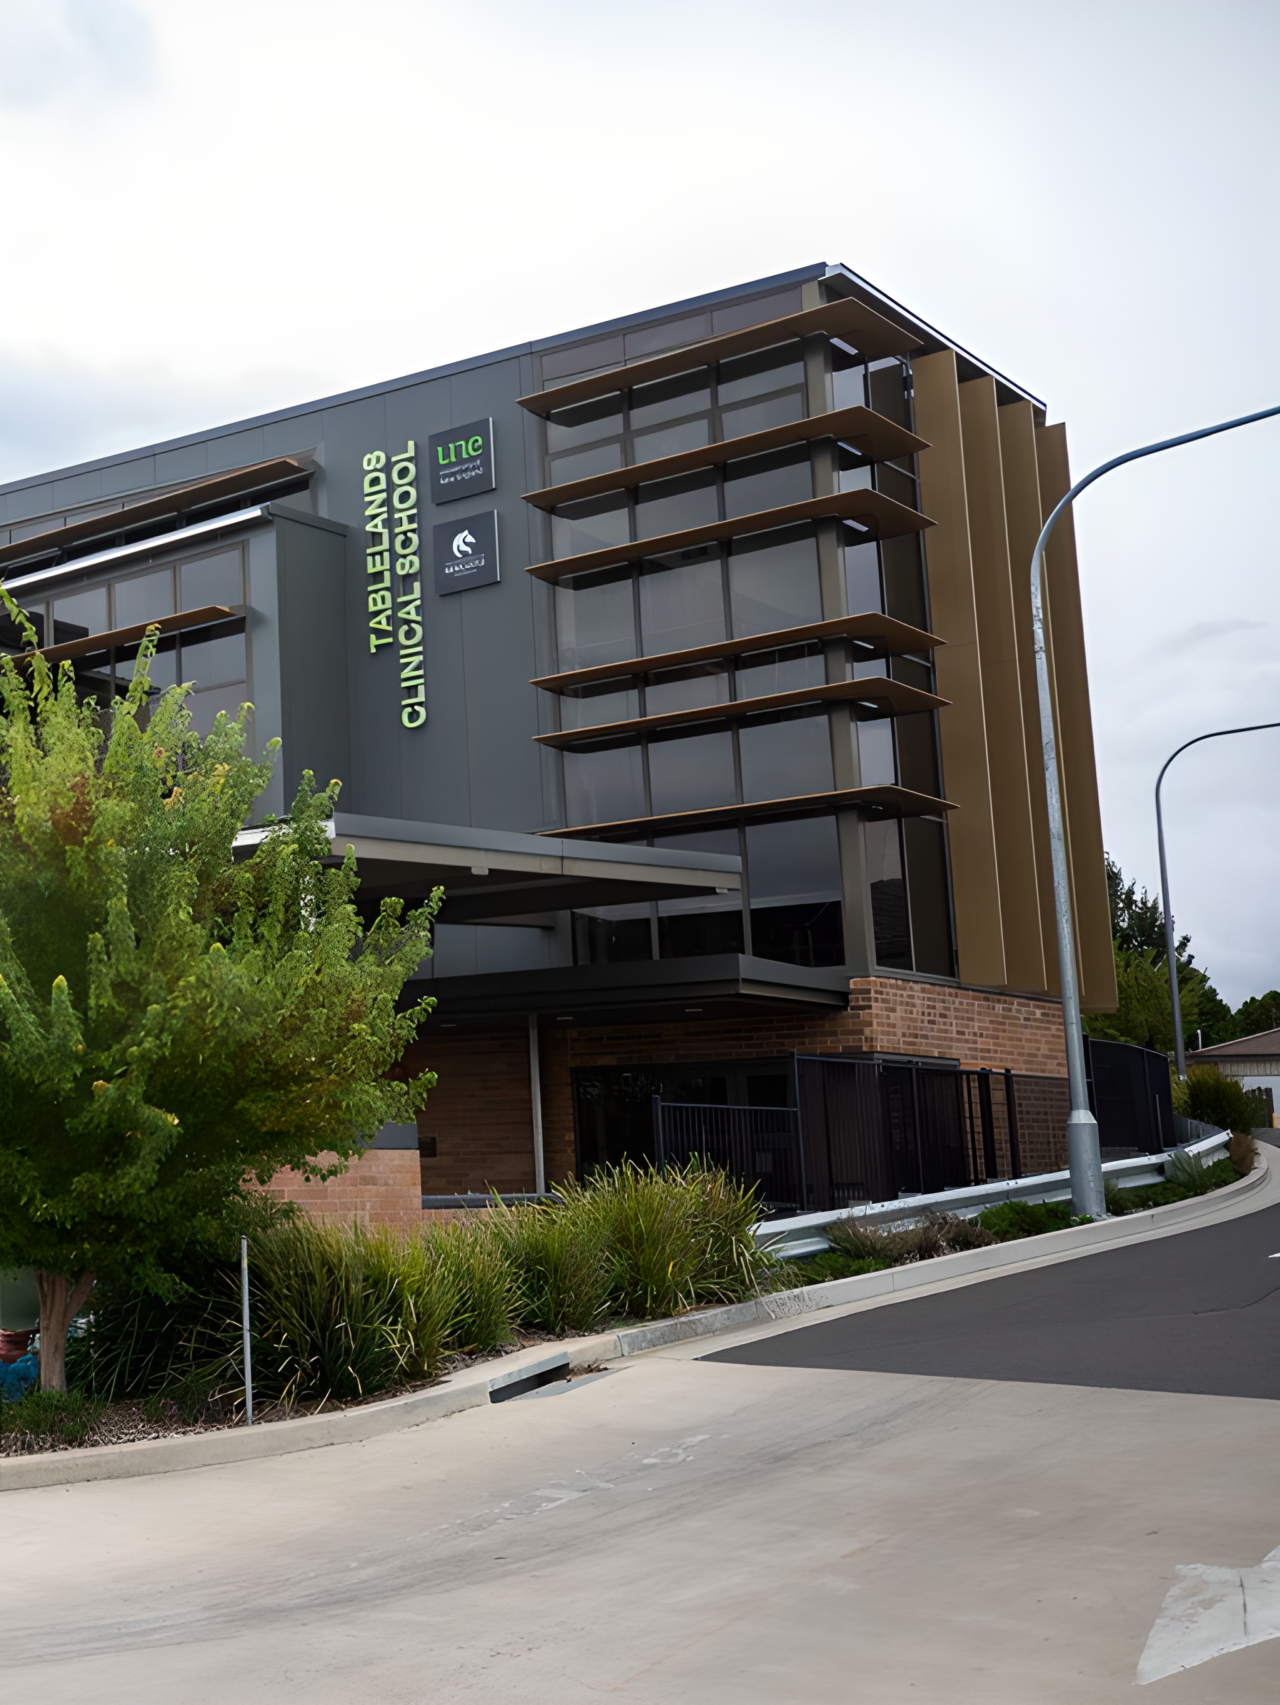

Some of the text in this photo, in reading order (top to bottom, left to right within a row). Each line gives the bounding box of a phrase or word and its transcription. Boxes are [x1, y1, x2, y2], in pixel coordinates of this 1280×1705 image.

[362, 450, 393, 654] TABLELANDS
[437, 435, 483, 465] une
[390, 440, 427, 729] CLINICAL SCHOOL
